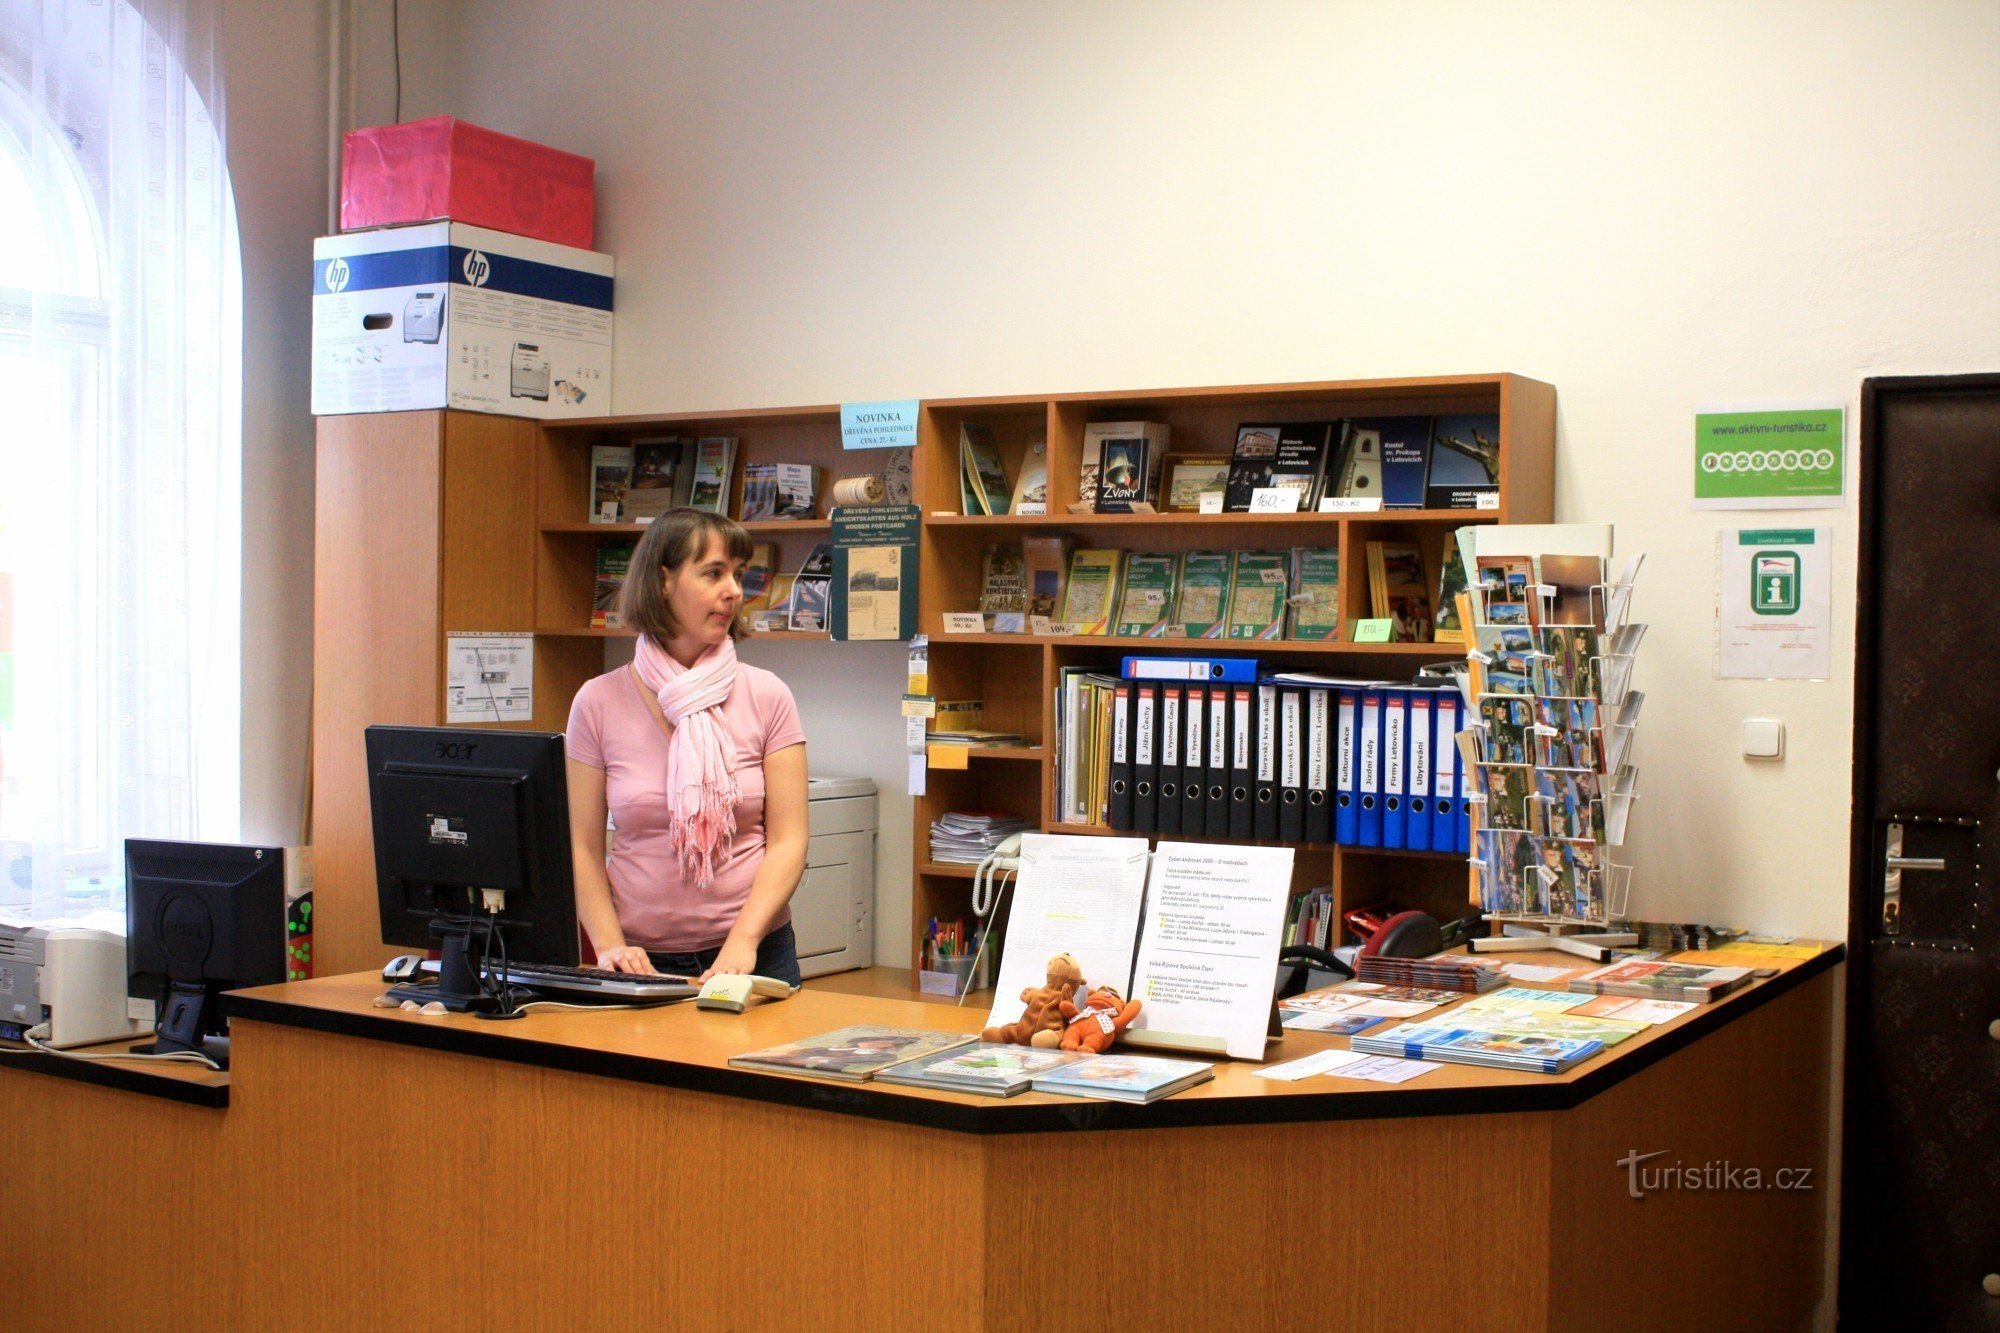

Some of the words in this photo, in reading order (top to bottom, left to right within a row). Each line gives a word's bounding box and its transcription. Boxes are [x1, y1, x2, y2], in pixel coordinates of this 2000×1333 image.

[856, 412, 901, 424] NOVINKA
[874, 424, 914, 434] POHLEDNICE
[1050, 626, 1071, 634] 109,-
[1363, 625, 1383, 634] 150,-
[1142, 706, 1151, 730] Čechy
[433, 742, 478, 759] acer
[1366, 740, 1374, 759] řády
[1390, 762, 1398, 786] Firmy
